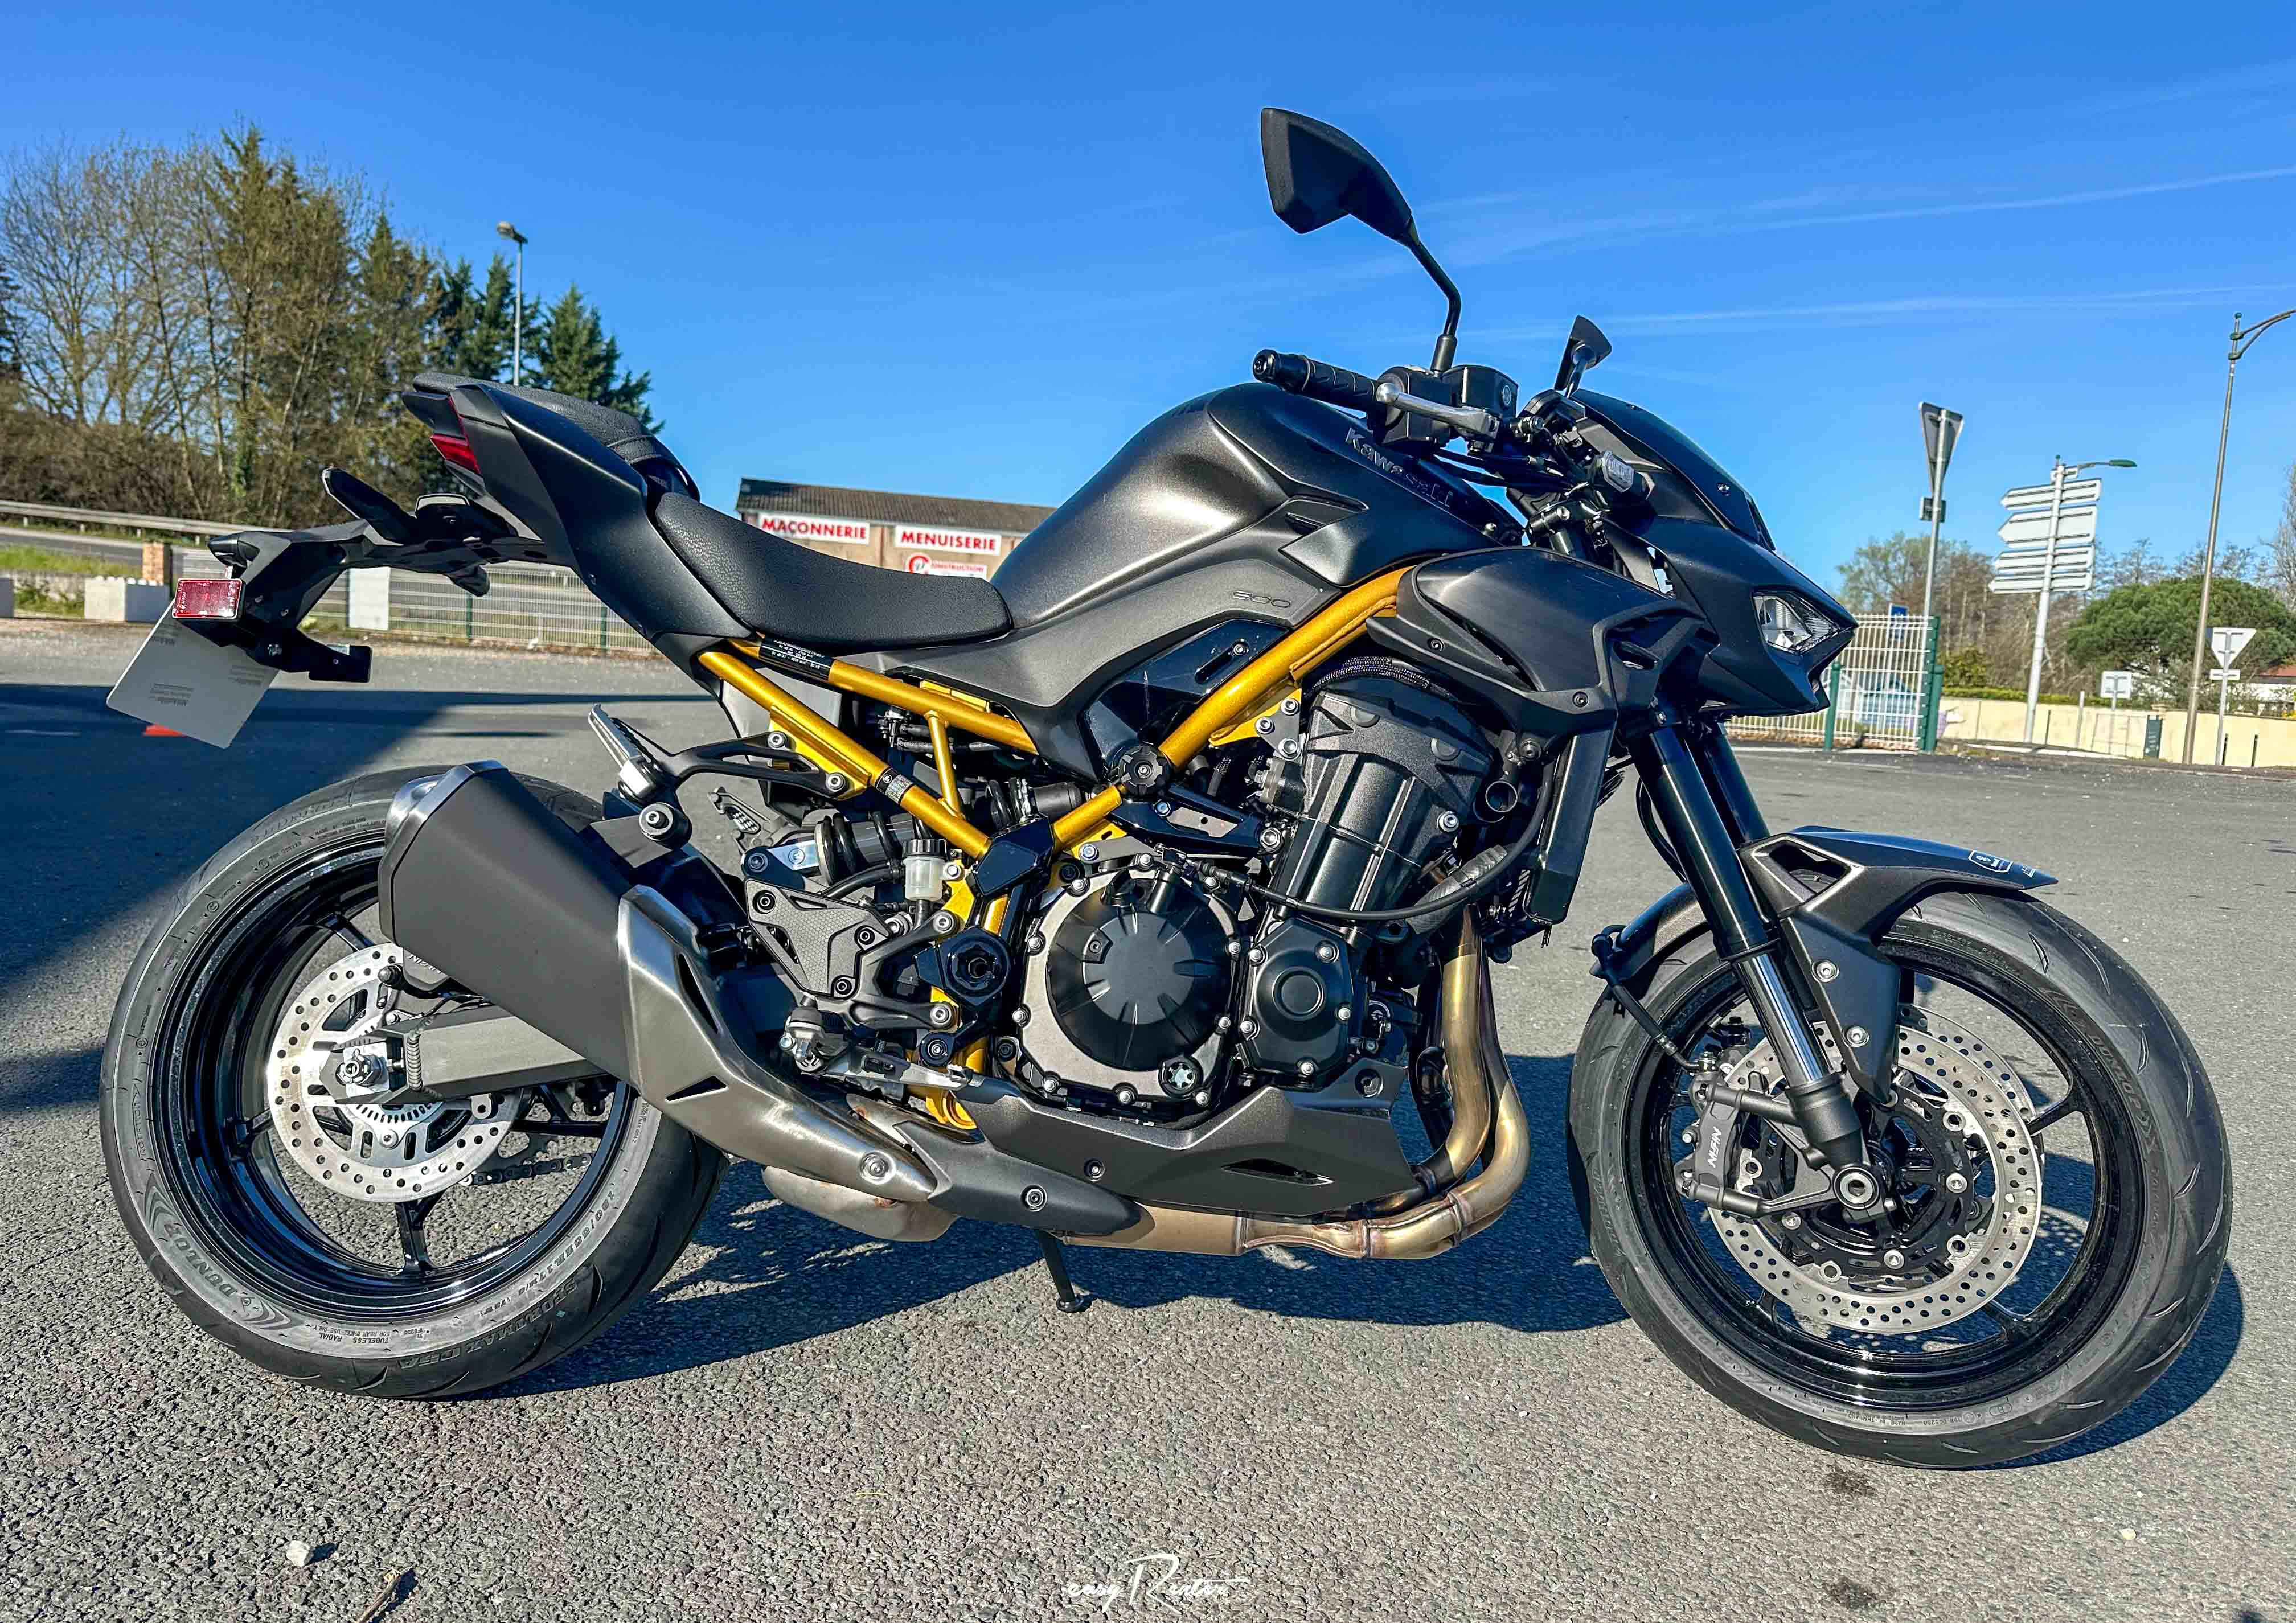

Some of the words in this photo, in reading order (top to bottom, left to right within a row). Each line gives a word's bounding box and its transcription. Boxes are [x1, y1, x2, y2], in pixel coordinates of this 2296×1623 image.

[901, 531, 996, 550] MENUISERIE
[164, 1224, 237, 1298] DUNLOP
[319, 1332, 342, 1342] RADIAL
